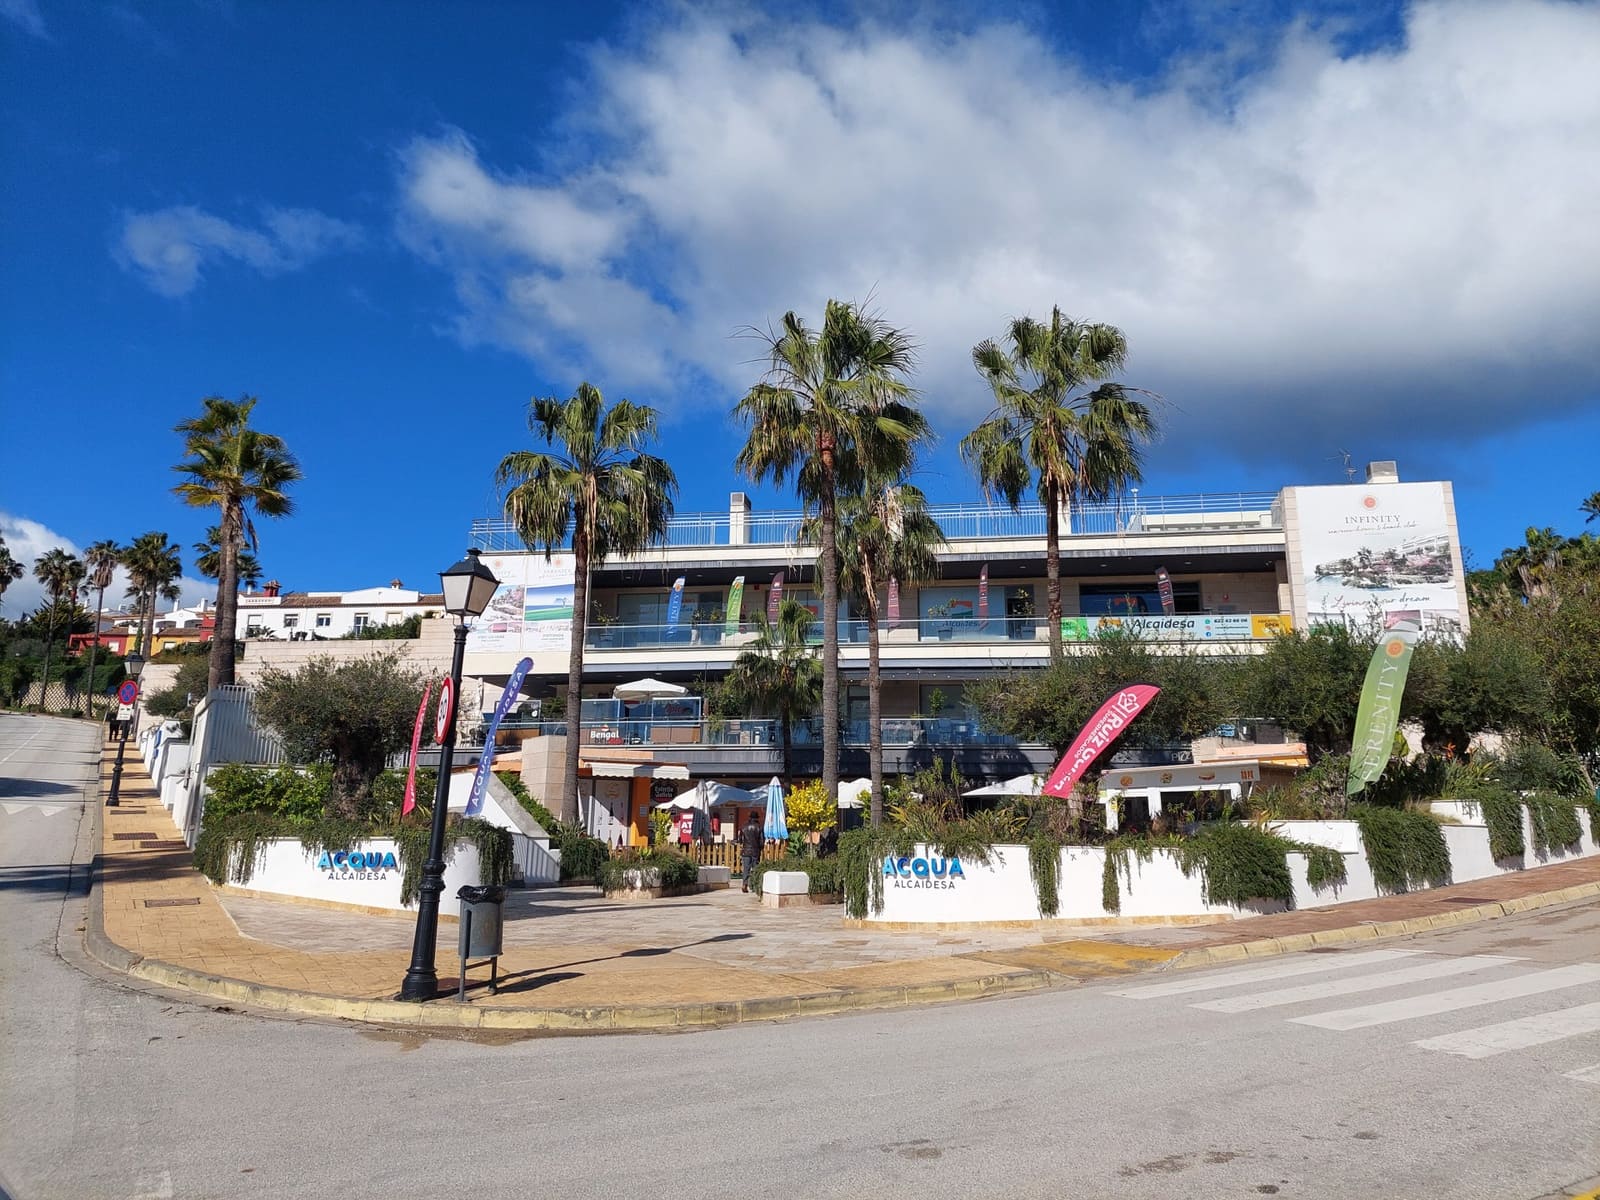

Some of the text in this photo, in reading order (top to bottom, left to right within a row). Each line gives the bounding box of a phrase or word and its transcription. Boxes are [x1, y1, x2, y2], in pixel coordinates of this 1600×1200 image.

[1345, 515, 1400, 524] INFINITY
[1134, 618, 1195, 629] Alcaidesa
[1361, 659, 1399, 781] SERENITY
[591, 730, 619, 739] Bengal
[1091, 710, 1125, 749] Ruiz
[318, 850, 396, 869] ACQUA
[883, 856, 963, 876] ACQUA
[328, 872, 387, 881] ALCAIDESA
[894, 880, 955, 889] ALCAIDESA
